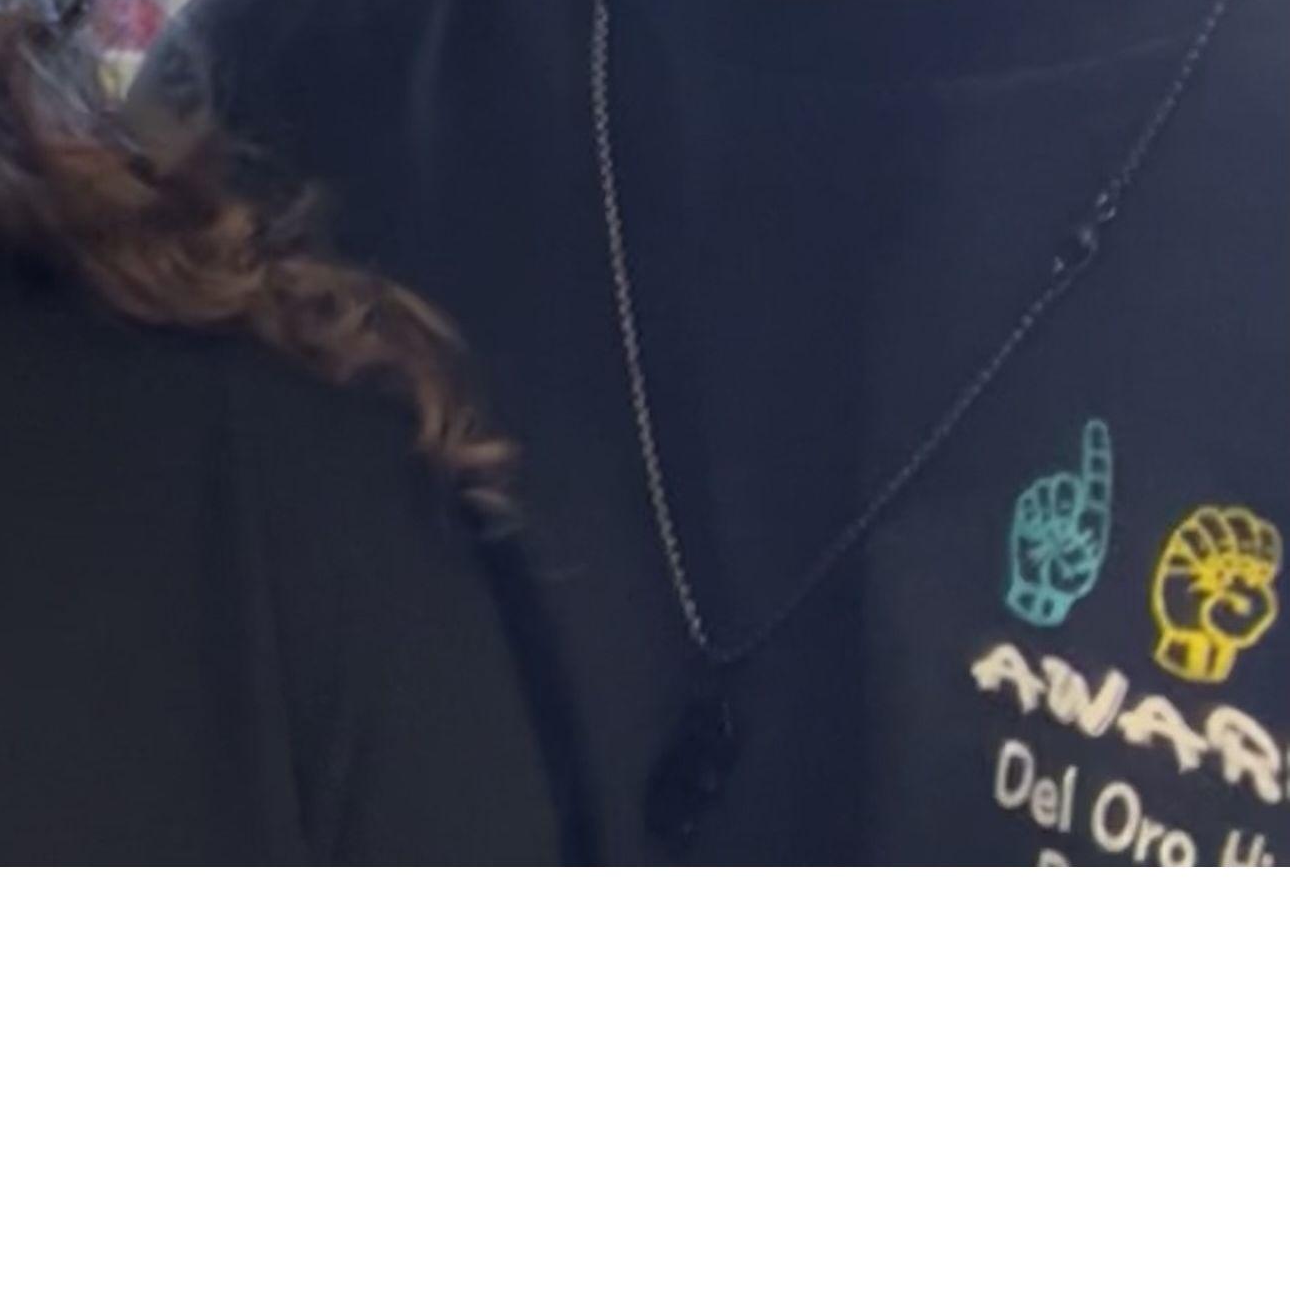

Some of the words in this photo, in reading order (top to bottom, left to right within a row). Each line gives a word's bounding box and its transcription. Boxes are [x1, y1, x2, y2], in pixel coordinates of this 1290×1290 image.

[970, 642, 1290, 805] AWAR
[995, 737, 1078, 834] Del
[1090, 780, 1198, 867] Oro
